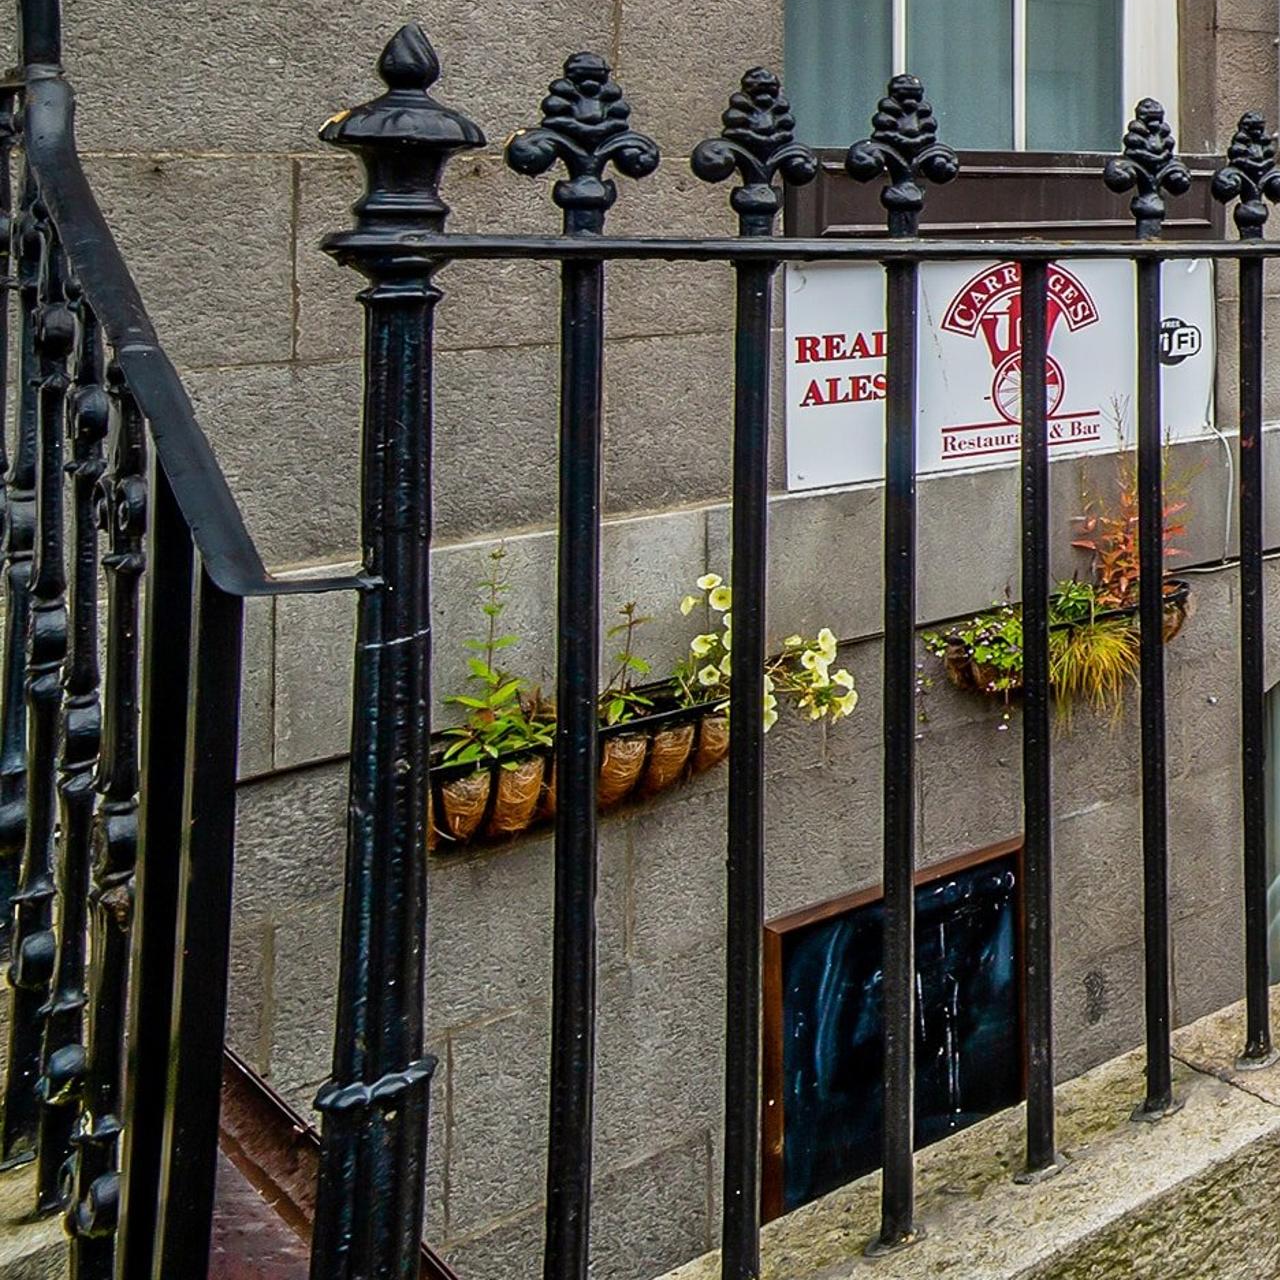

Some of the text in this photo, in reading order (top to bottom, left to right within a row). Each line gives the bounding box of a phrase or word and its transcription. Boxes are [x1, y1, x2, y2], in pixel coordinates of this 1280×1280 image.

[954, 267, 1090, 326] CARRGES
[1160, 332, 1194, 351] iFi
[800, 374, 886, 407] ALES
[1050, 423, 1063, 439] &
[1071, 421, 1100, 436] Bar
